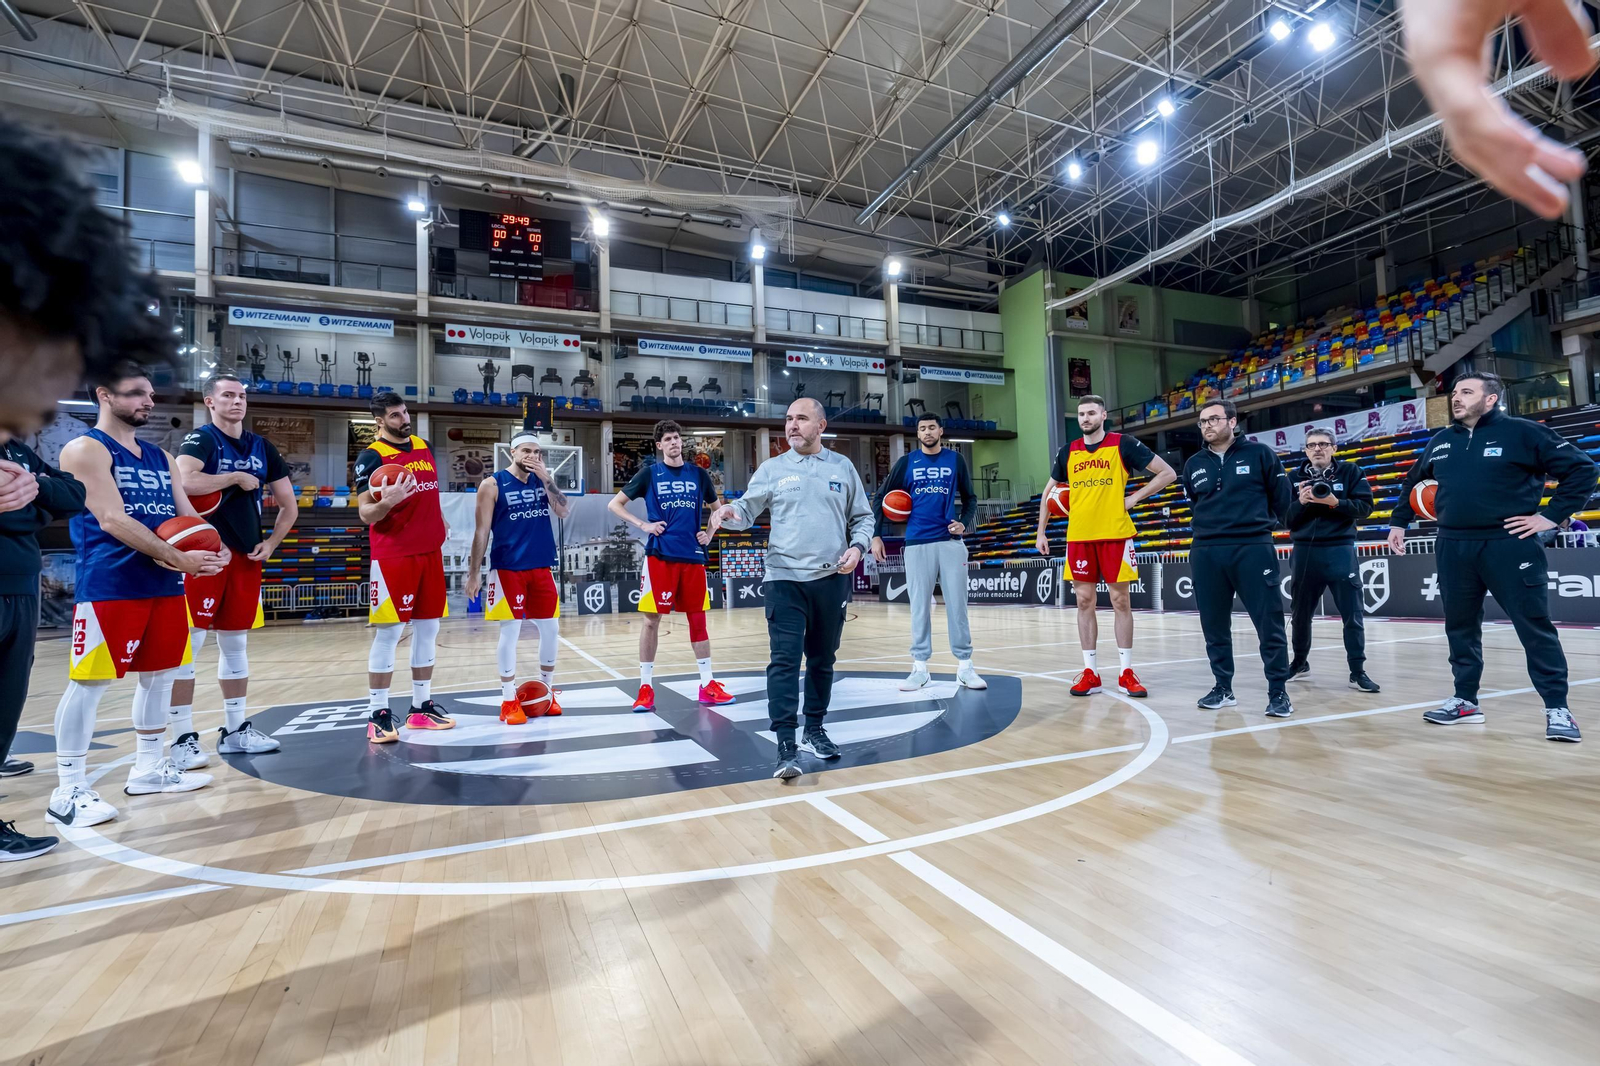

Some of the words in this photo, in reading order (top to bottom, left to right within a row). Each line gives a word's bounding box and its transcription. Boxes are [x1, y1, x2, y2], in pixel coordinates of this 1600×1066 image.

[503, 214, 530, 226] 29:49
[494, 229, 507, 239] 00
[529, 233, 541, 243] 00
[246, 311, 311, 323] WITZENMANN
[331, 318, 392, 330] WITZENMANN
[468, 327, 511, 344] Volapük
[519, 331, 559, 347] Volapük
[648, 342, 695, 352] WITZENMANN
[707, 347, 751, 357] WITZENMANN
[803, 353, 835, 367] Volapük
[840, 356, 870, 369] Volapük
[927, 369, 962, 377] WITZENMANN
[970, 372, 1004, 380] WITZENMANN
[912, 466, 952, 481] ESP
[1073, 458, 1111, 474] ESPAÑA
[656, 480, 697, 495] ESP
[915, 485, 949, 495] endesa
[1072, 477, 1114, 489] endesa
[504, 487, 547, 506] ESP
[661, 498, 696, 510] endesa
[124, 500, 176, 516] endes
[509, 508, 549, 521] endesa
[1371, 561, 1385, 569] FEB
[370, 581, 379, 606] ESP
[487, 583, 496, 606] ESP
[74, 618, 87, 656] ESP
